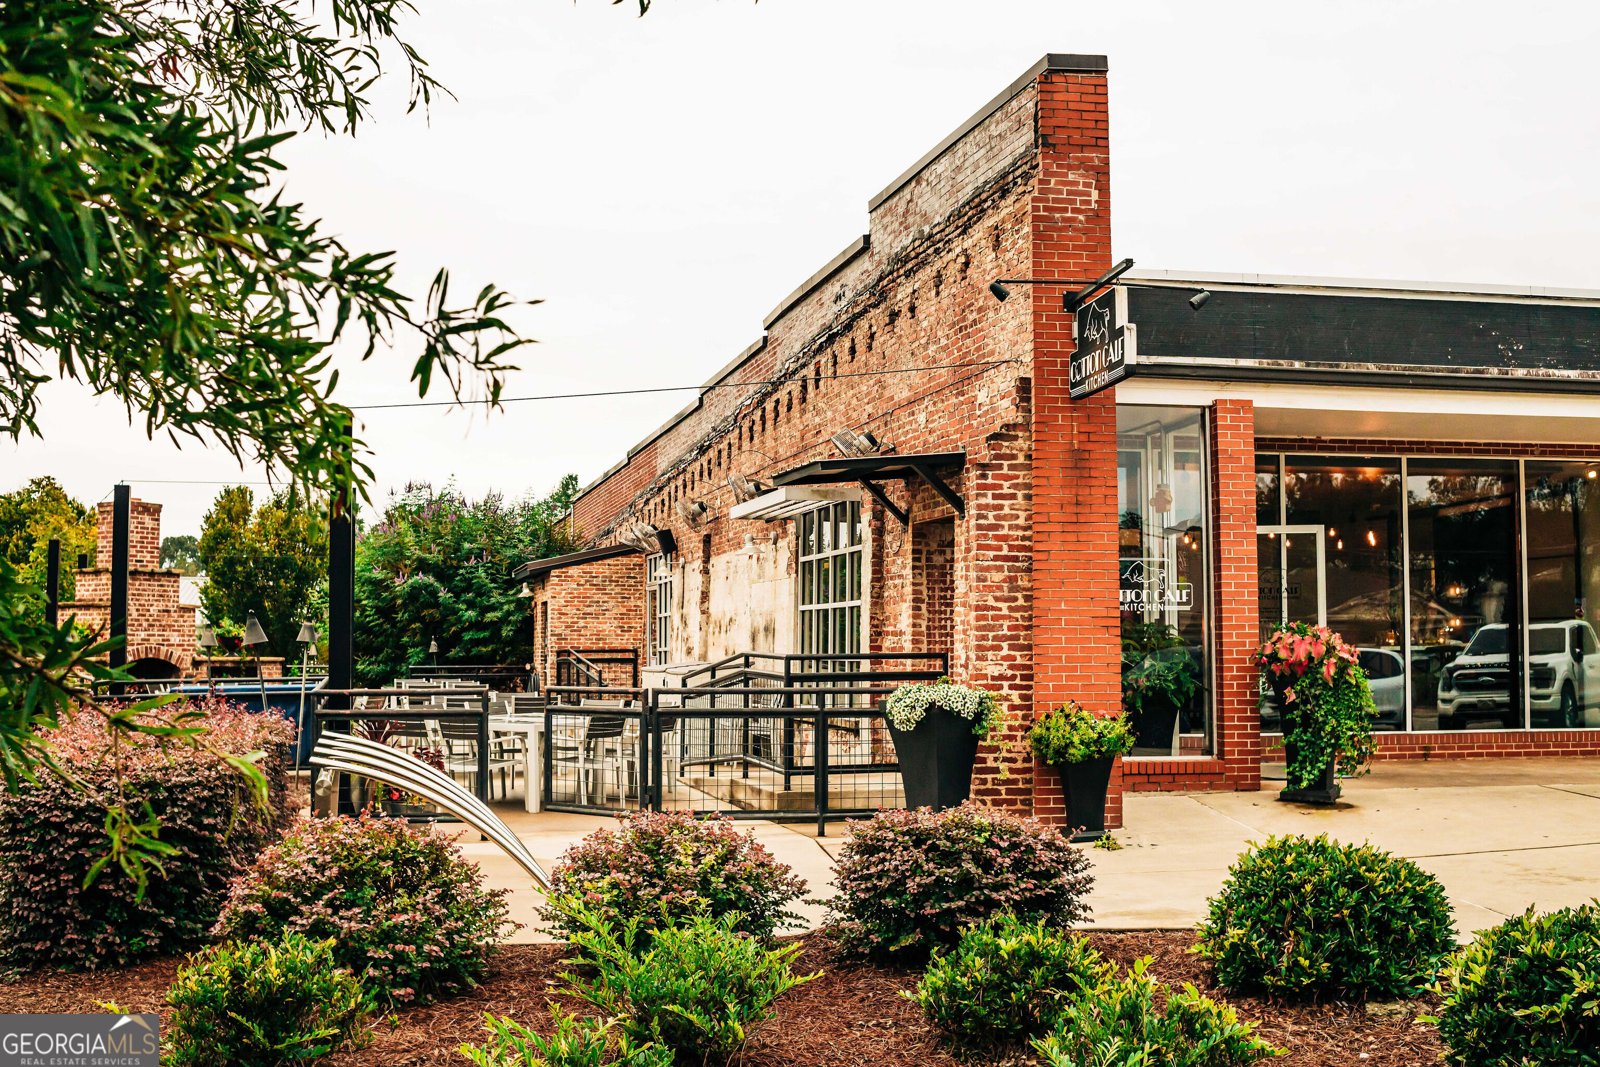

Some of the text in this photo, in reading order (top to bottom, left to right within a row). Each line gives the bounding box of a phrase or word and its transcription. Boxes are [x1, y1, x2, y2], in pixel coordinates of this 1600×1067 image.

[1102, 336, 1124, 368] CALF
[1085, 370, 1109, 392] KITCHEN
[1119, 589, 1190, 602] TTON CALF
[1124, 603, 1164, 611] KITCHEN
